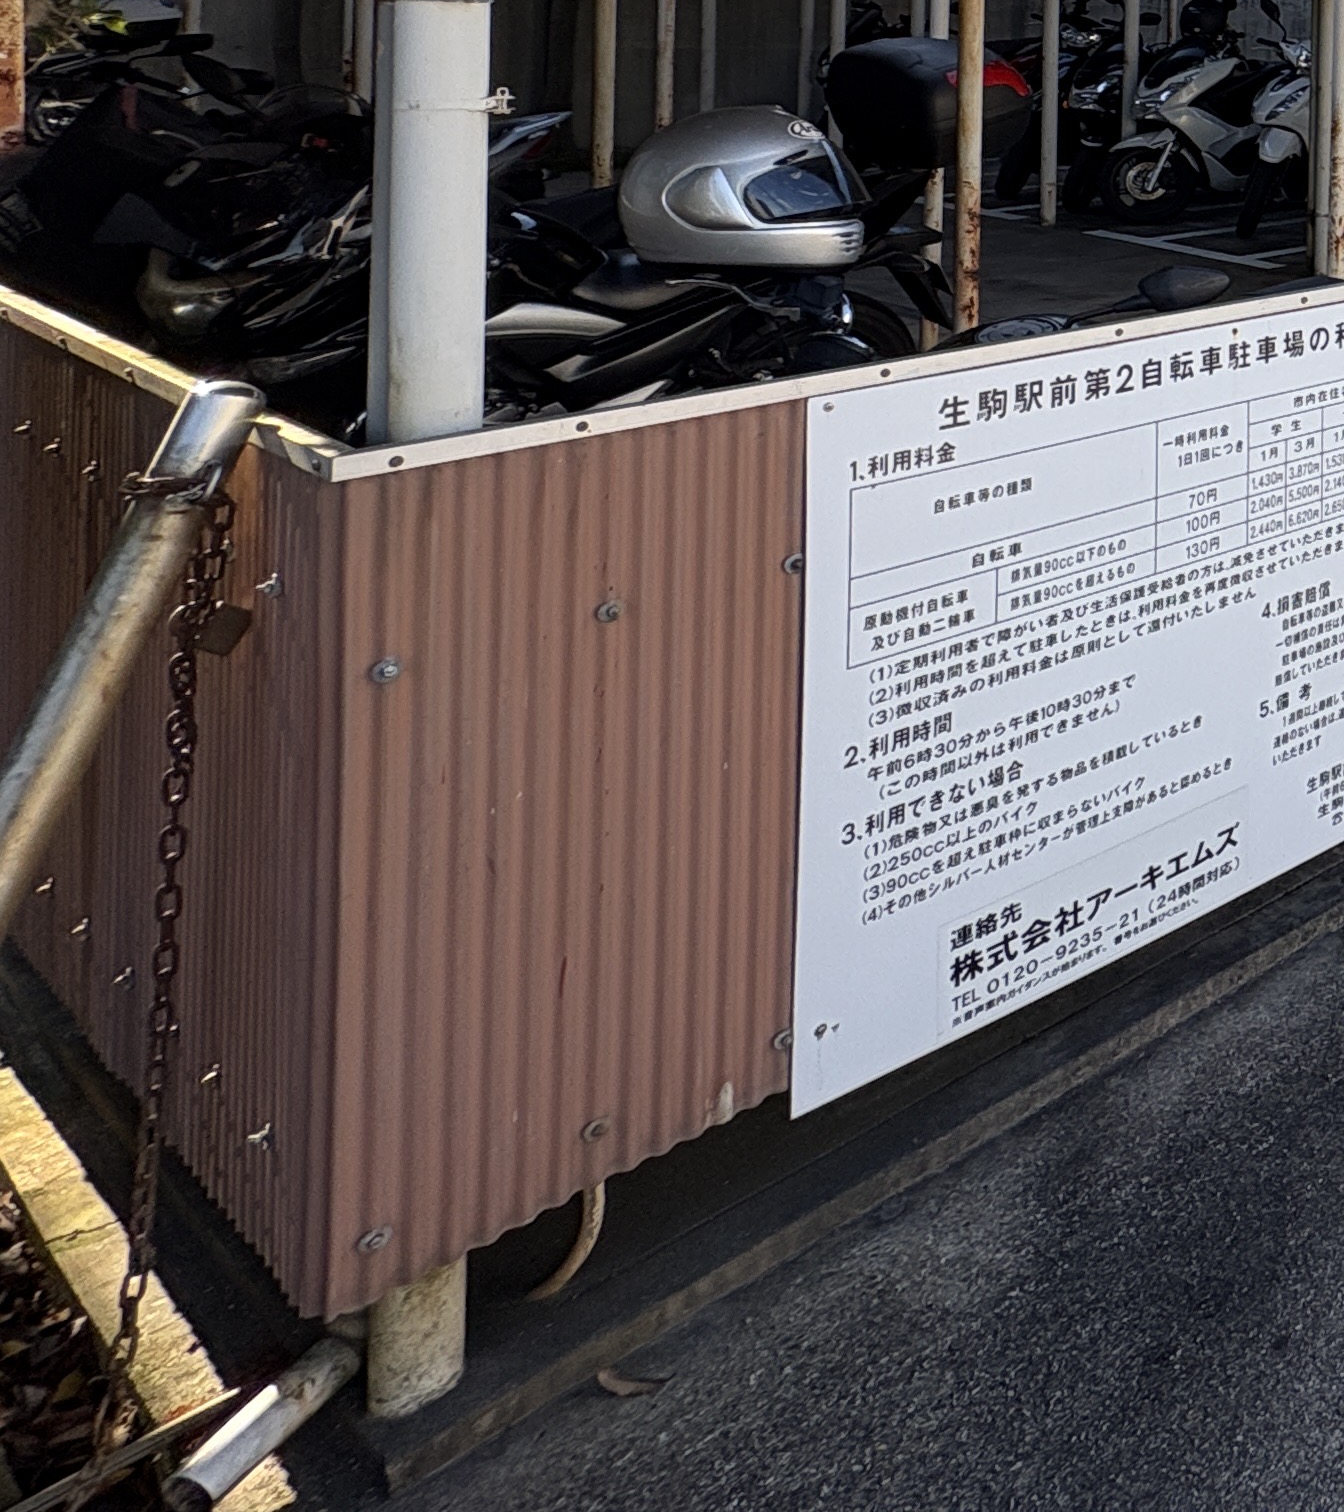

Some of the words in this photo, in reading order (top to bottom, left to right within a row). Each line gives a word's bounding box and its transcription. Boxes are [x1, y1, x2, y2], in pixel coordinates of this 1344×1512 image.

[1162, 424, 1230, 448] 一時利用料金
[933, 477, 1033, 515] 自転車等の種類
[1188, 488, 1218, 510] 70円
[1185, 511, 1221, 534] 100円
[971, 542, 1023, 569] 自転車
[1010, 539, 1127, 584] 排気量90cc以下のもの
[1185, 536, 1221, 561] 130円
[1009, 563, 1136, 612] 排気量90ccを超えるもの
[862, 589, 969, 632] 原動機付自転車
[870, 609, 976, 653] 及び自動二輪車
[866, 674, 1137, 782] 午前6時30分から午後10時30分まで
[862, 801, 1038, 883] (2)250cc以上のバイク
[949, 821, 1241, 989] 株式会社アーキエムズ
[949, 902, 1023, 953] 連絡先
[950, 988, 983, 1013] TEL
